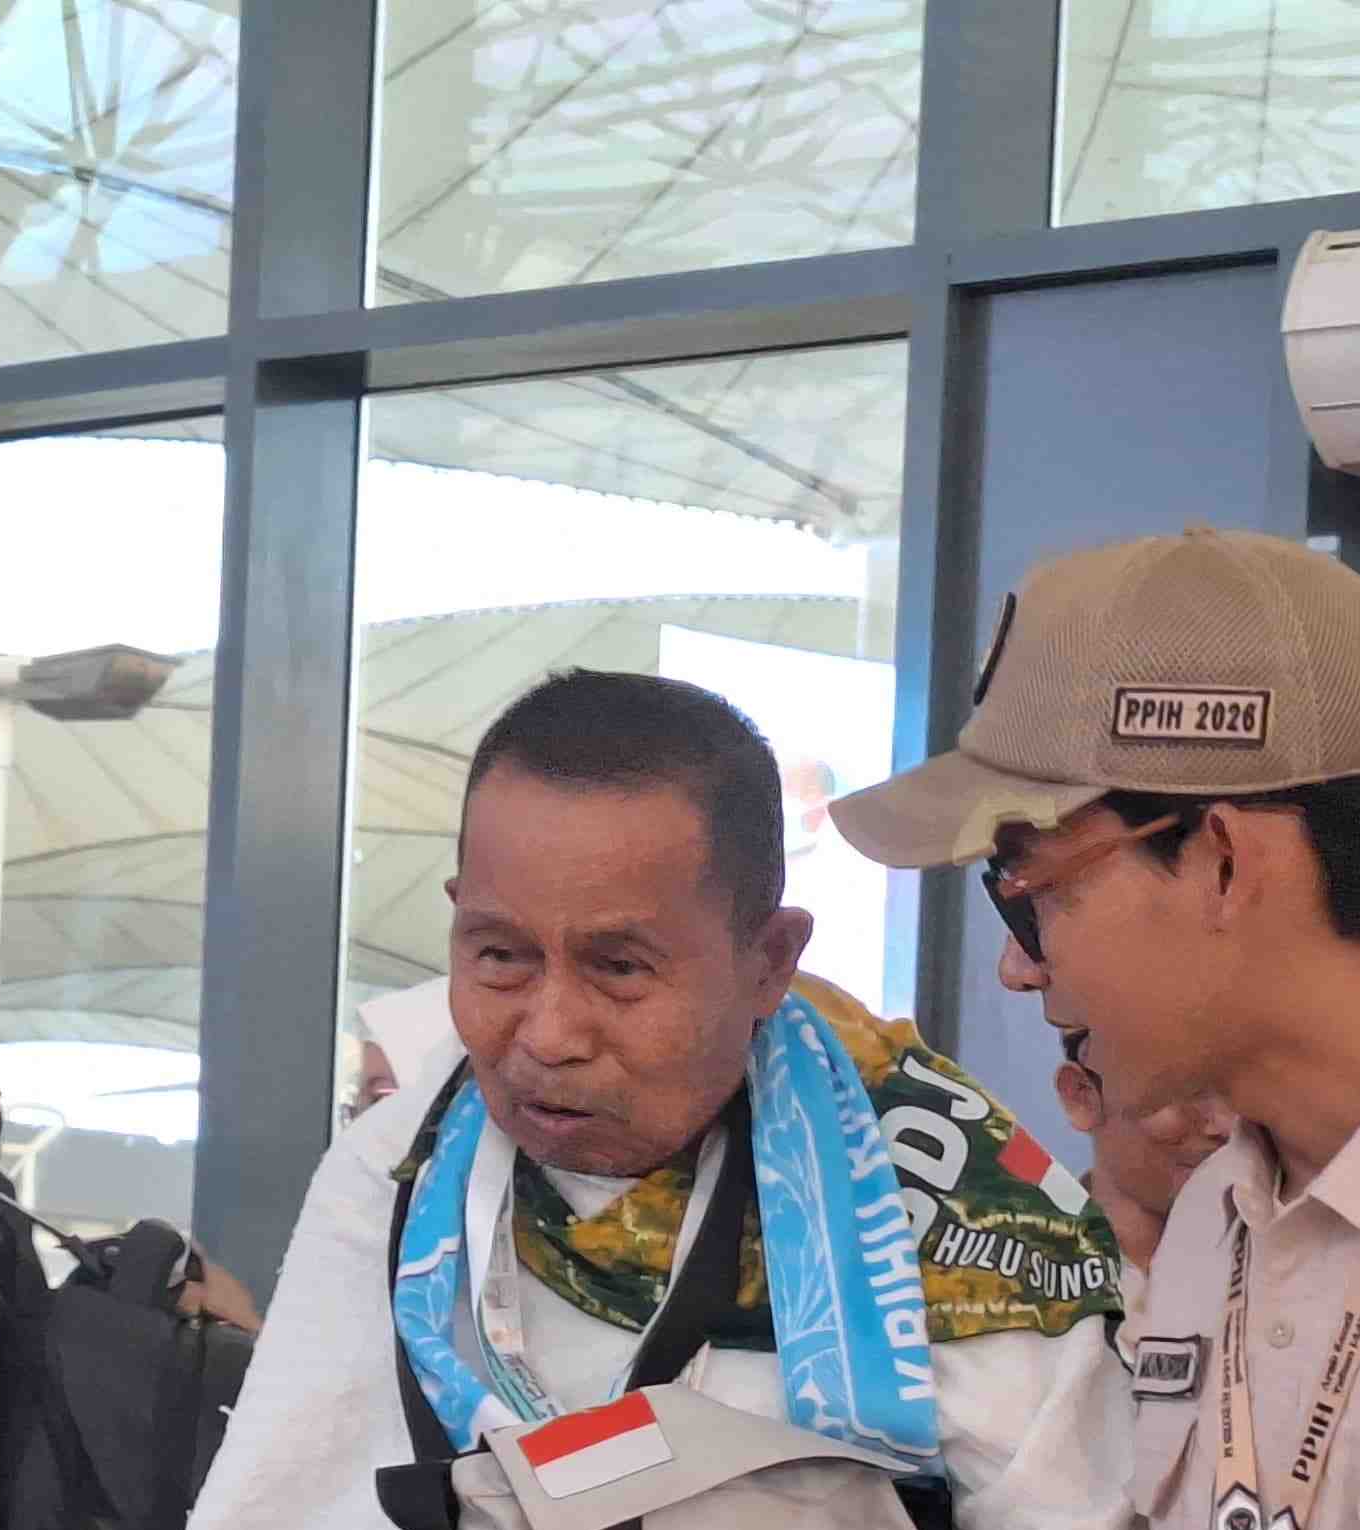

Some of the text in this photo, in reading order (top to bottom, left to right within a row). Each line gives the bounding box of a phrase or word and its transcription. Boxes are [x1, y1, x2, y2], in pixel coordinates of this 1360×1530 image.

[1123, 697, 1257, 731] PPIH 2026
[933, 1222, 1025, 1277] HULU
[1291, 1401, 1334, 1483] PPIH
